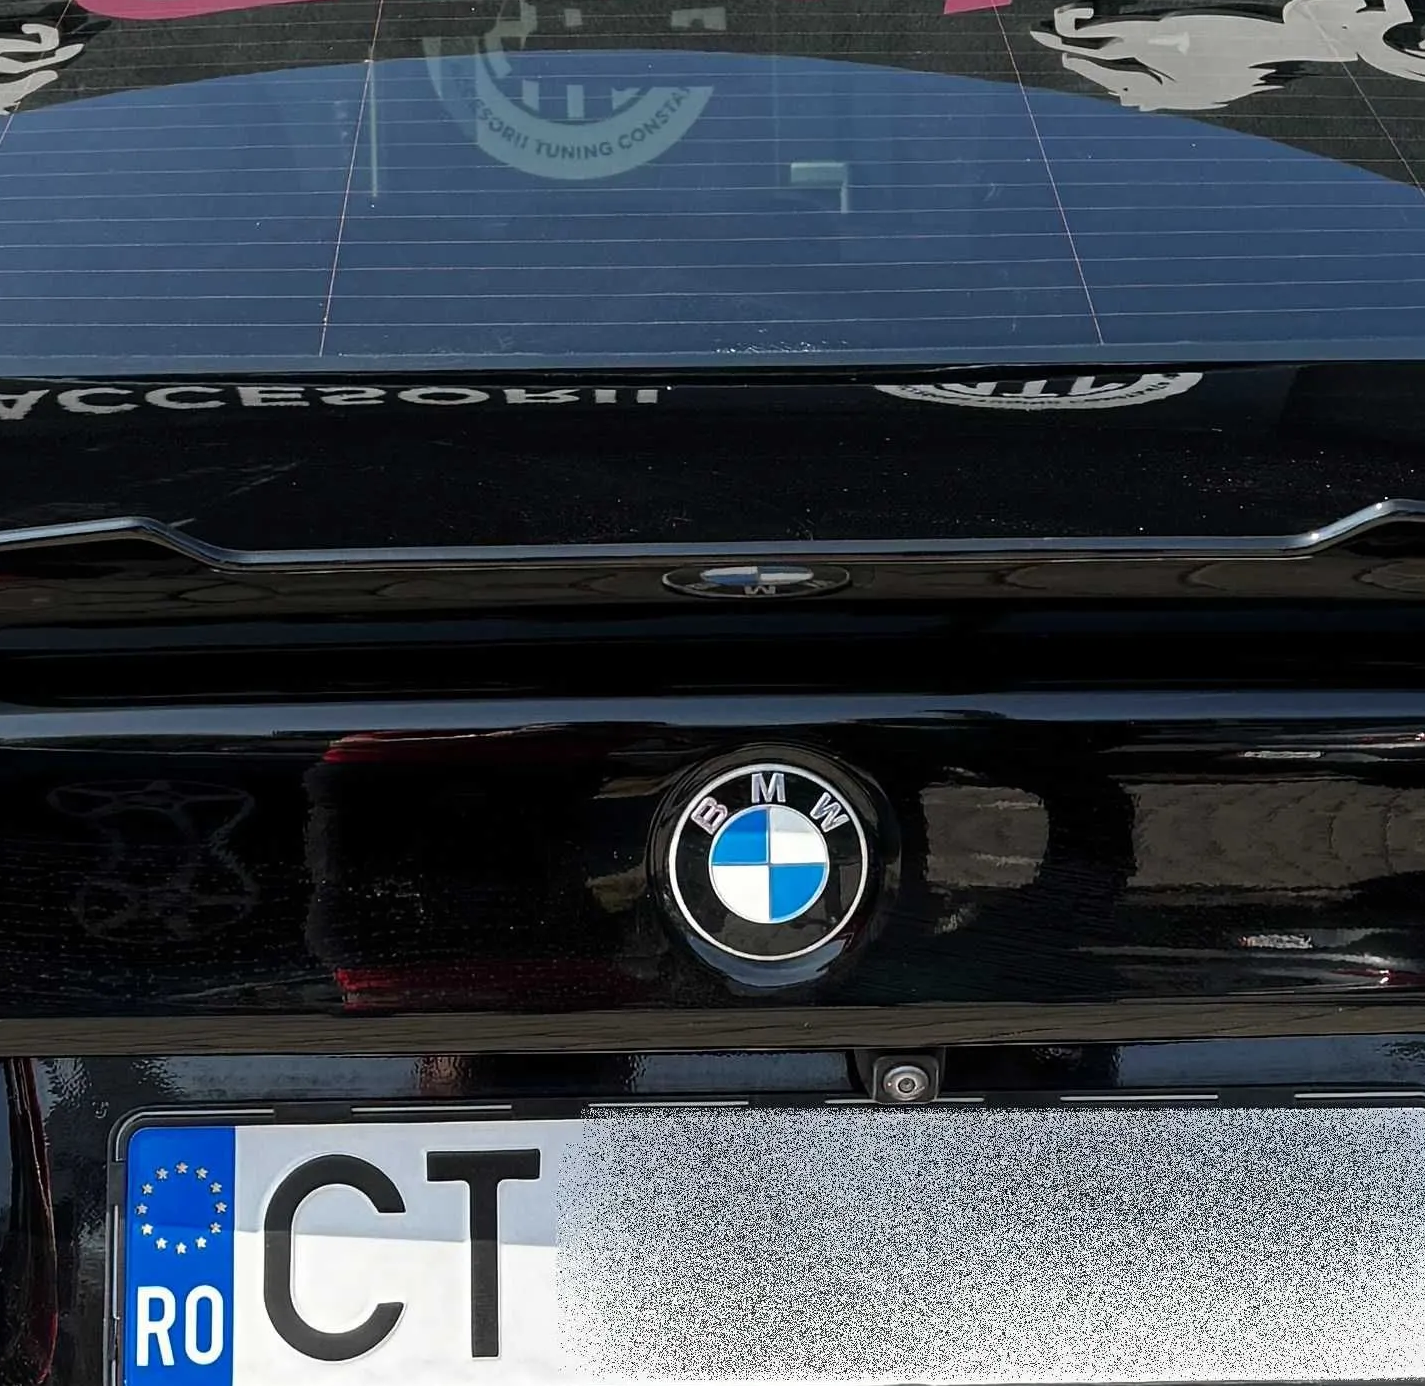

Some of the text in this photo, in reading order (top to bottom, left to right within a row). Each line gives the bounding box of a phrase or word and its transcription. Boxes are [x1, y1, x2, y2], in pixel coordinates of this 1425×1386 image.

[534, 138, 614, 161] TUNING
[690, 772, 850, 835] BMW
[262, 1147, 542, 1363] CT
[136, 1284, 225, 1367] RO
